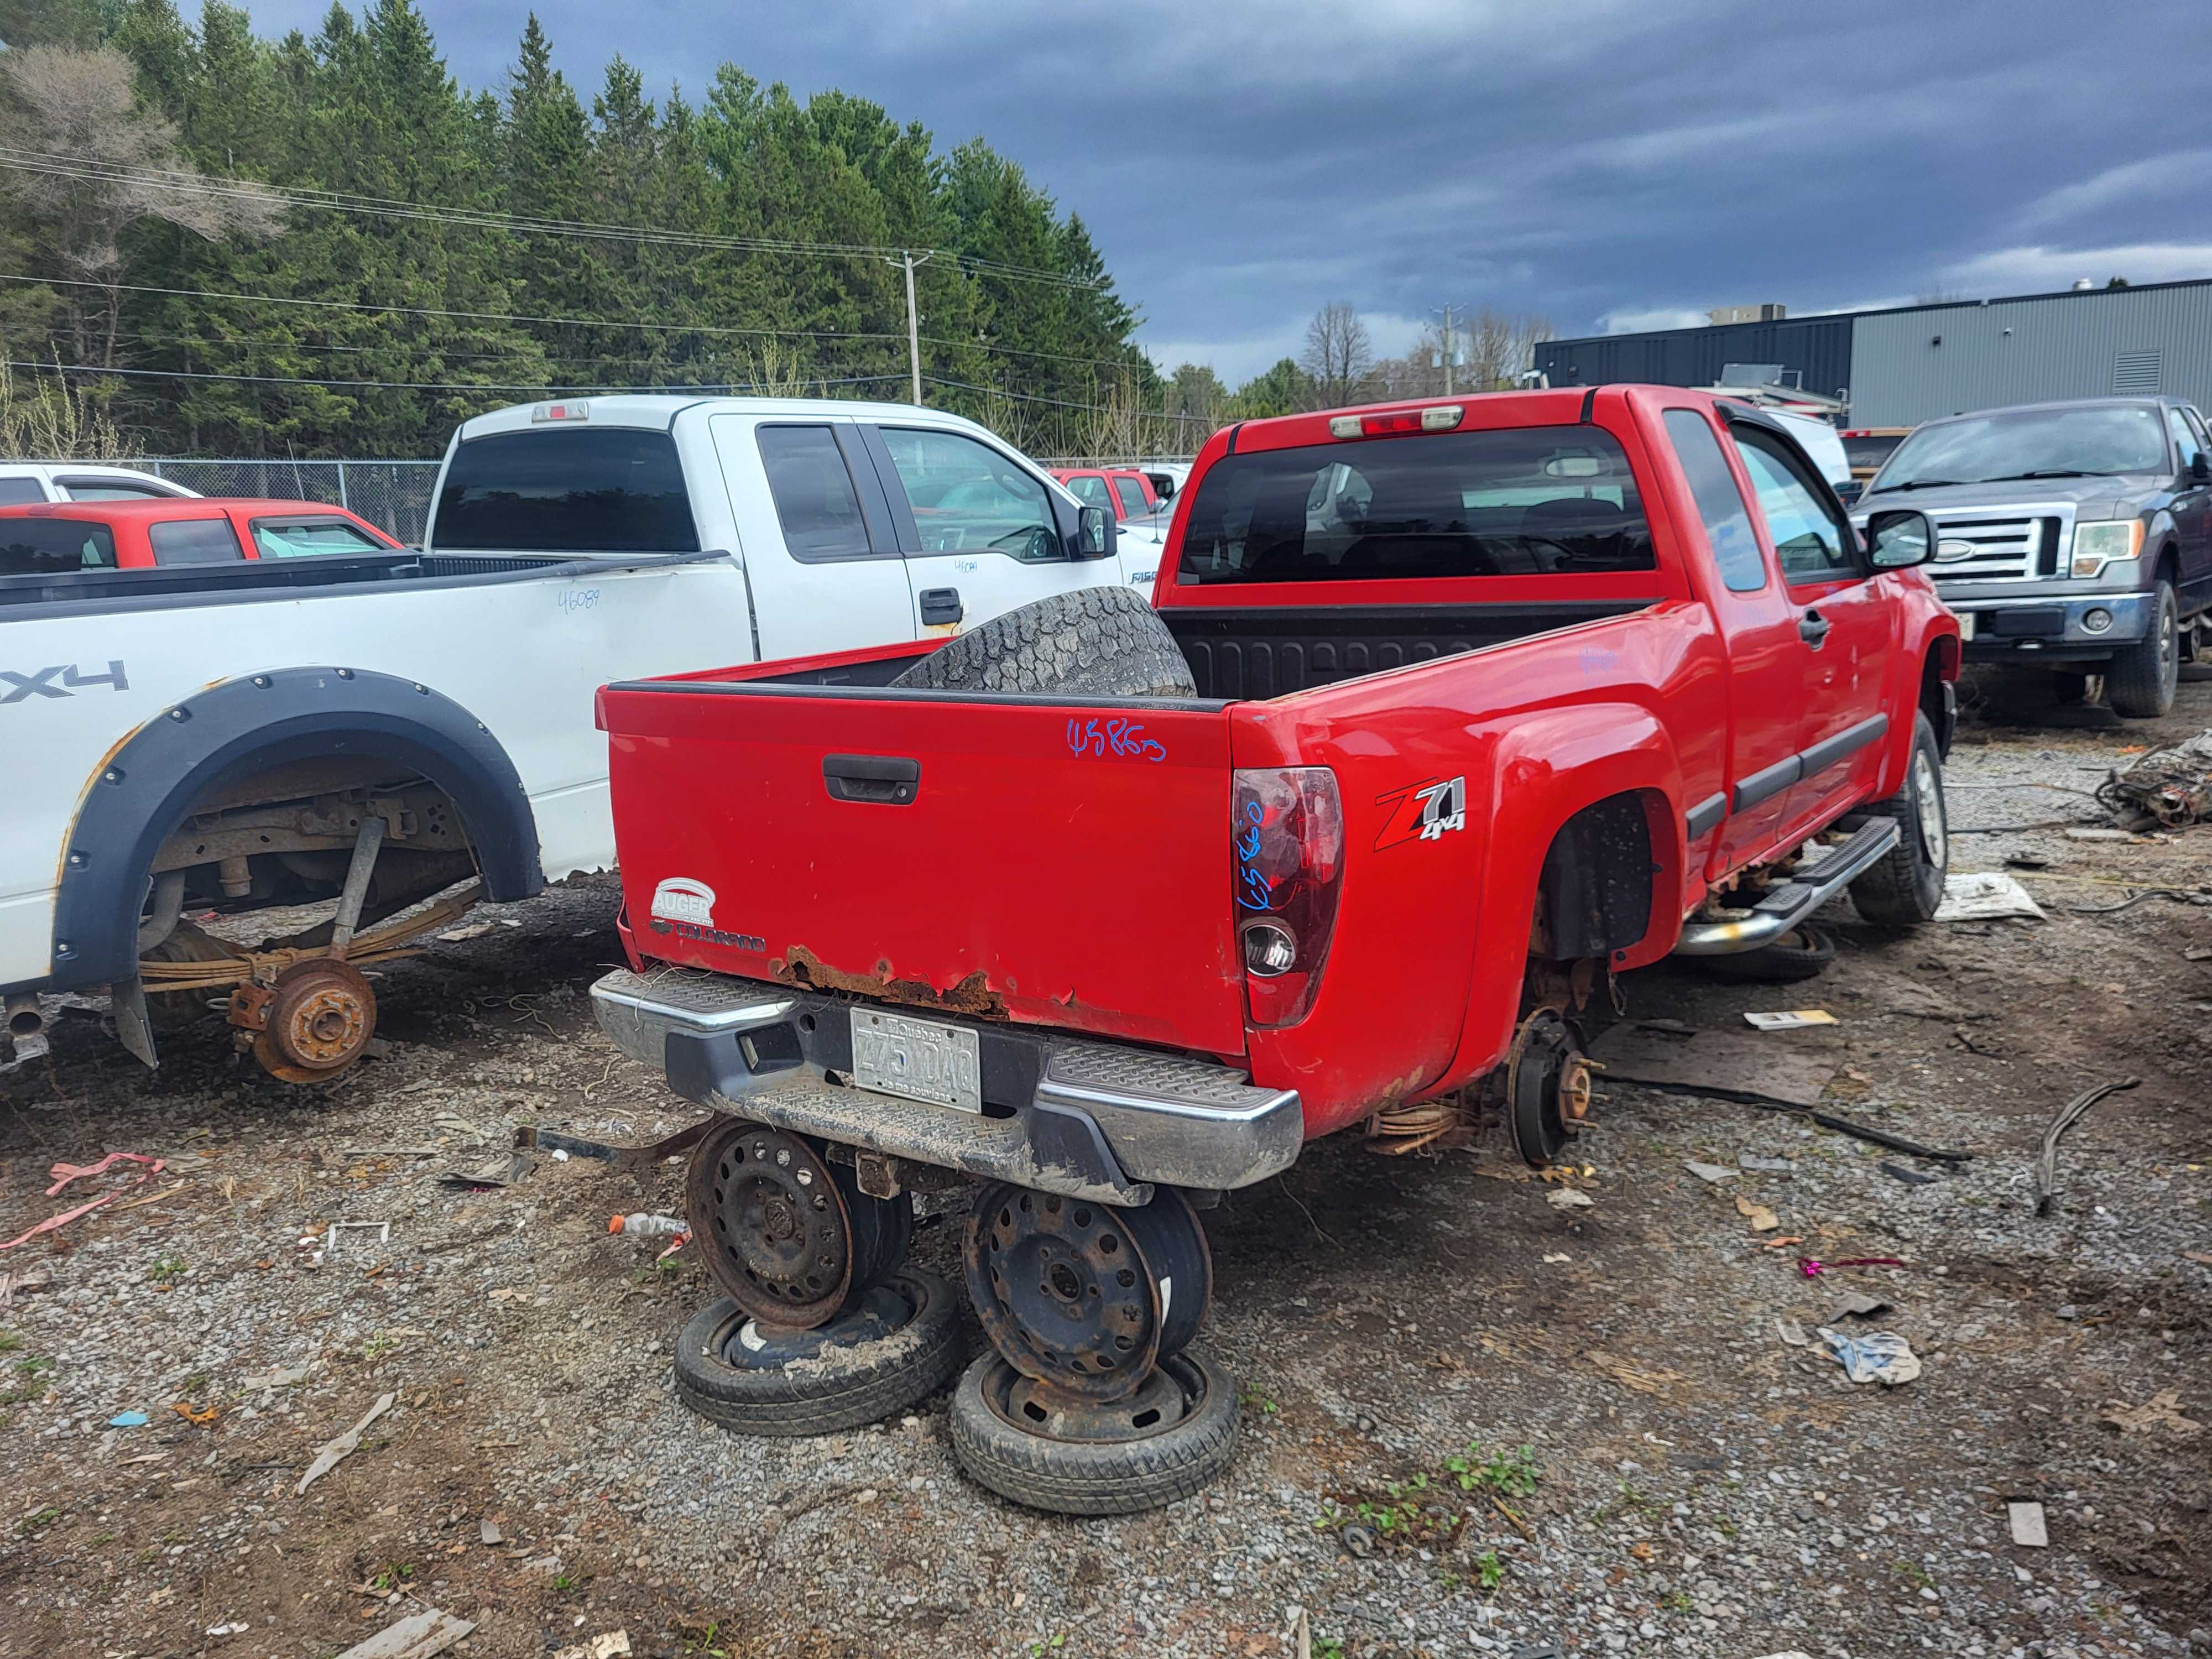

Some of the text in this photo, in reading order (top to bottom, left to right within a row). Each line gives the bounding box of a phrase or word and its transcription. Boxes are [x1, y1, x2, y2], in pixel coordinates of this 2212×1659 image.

[654, 890, 710, 918] AUGER
[676, 923, 766, 953] COLORADO
[898, 1022, 942, 1042] Québec
[910, 1085, 951, 1102] souviens
